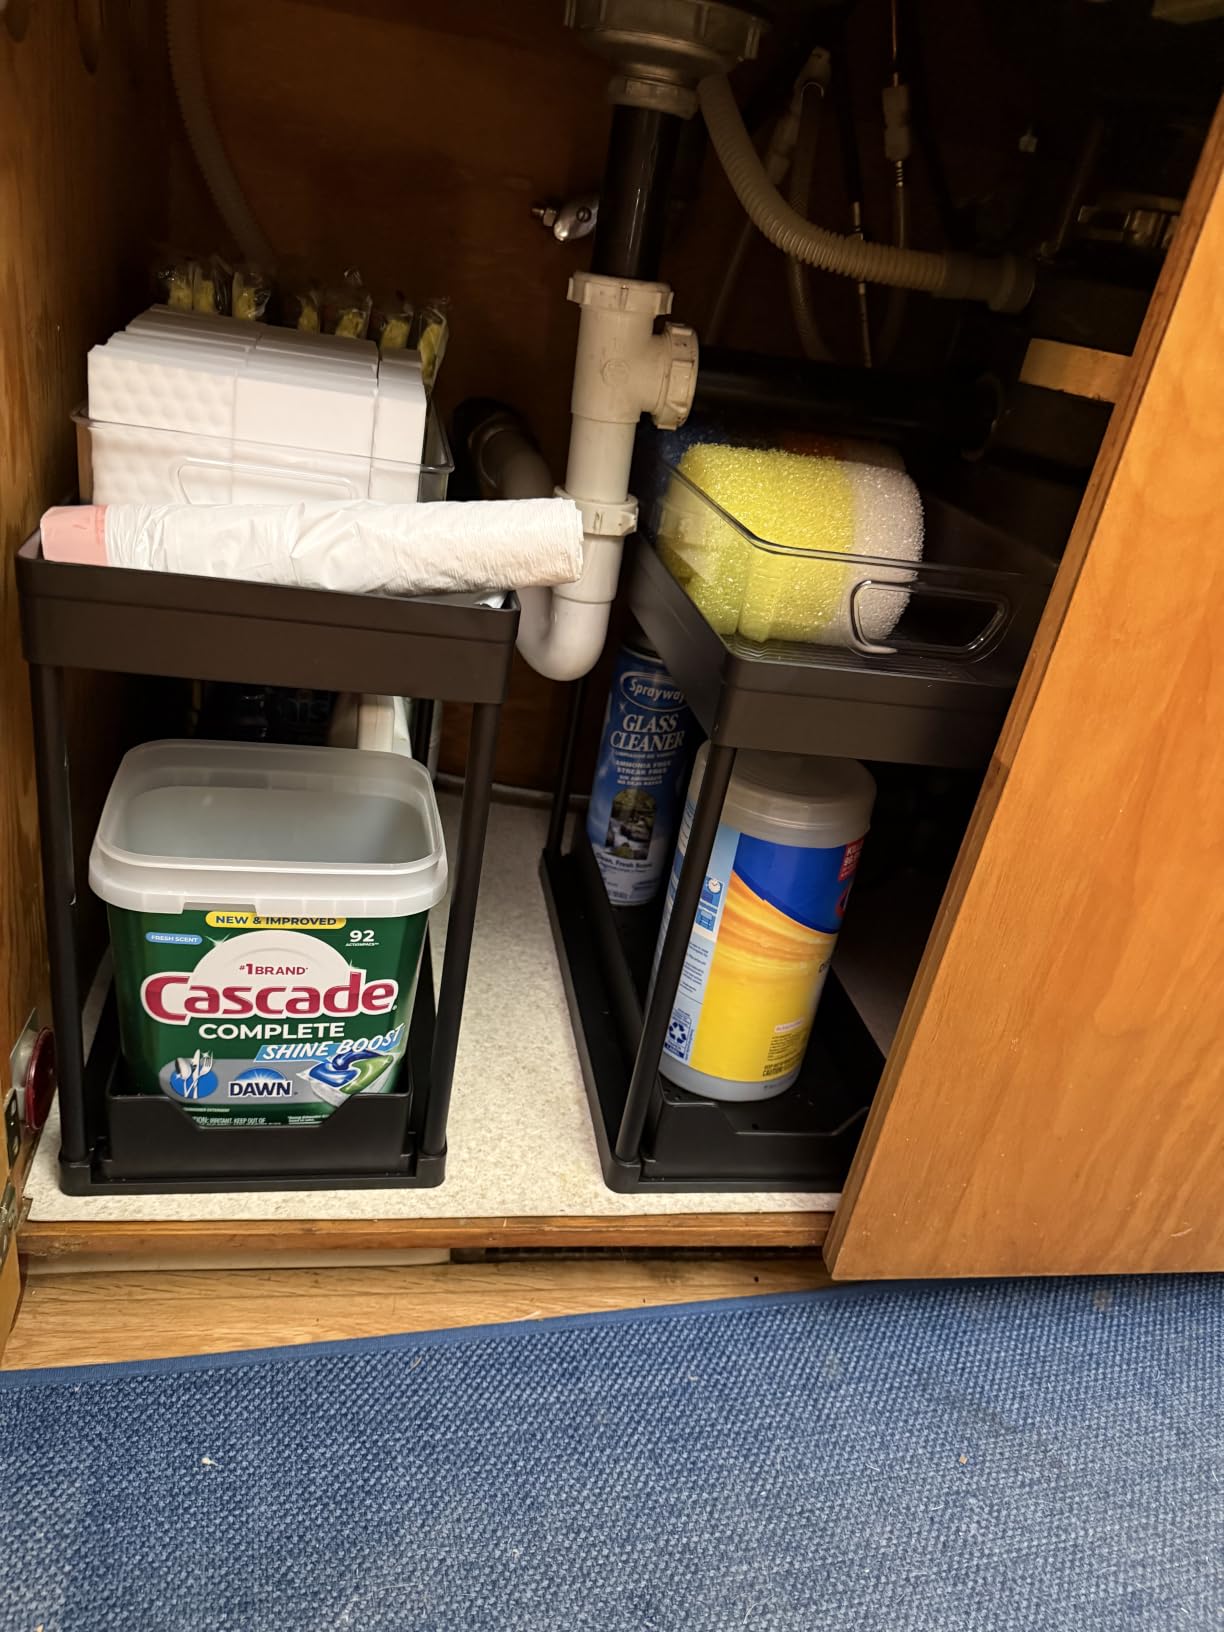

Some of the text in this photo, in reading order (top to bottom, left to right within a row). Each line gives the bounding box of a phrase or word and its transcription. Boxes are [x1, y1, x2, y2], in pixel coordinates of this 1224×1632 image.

[622, 713, 679, 734] GLASS
[610, 730, 686, 753] CLEANER
[215, 915, 337, 927] NEW & IMPROVED
[151, 934, 198, 945] FRESH SCENT
[349, 929, 375, 943] 92
[144, 972, 395, 1021] Cascade
[198, 1022, 345, 1040] COMPLETE
[262, 1024, 403, 1061] SHINE BOOST
[229, 1081, 292, 1097] DAWN
